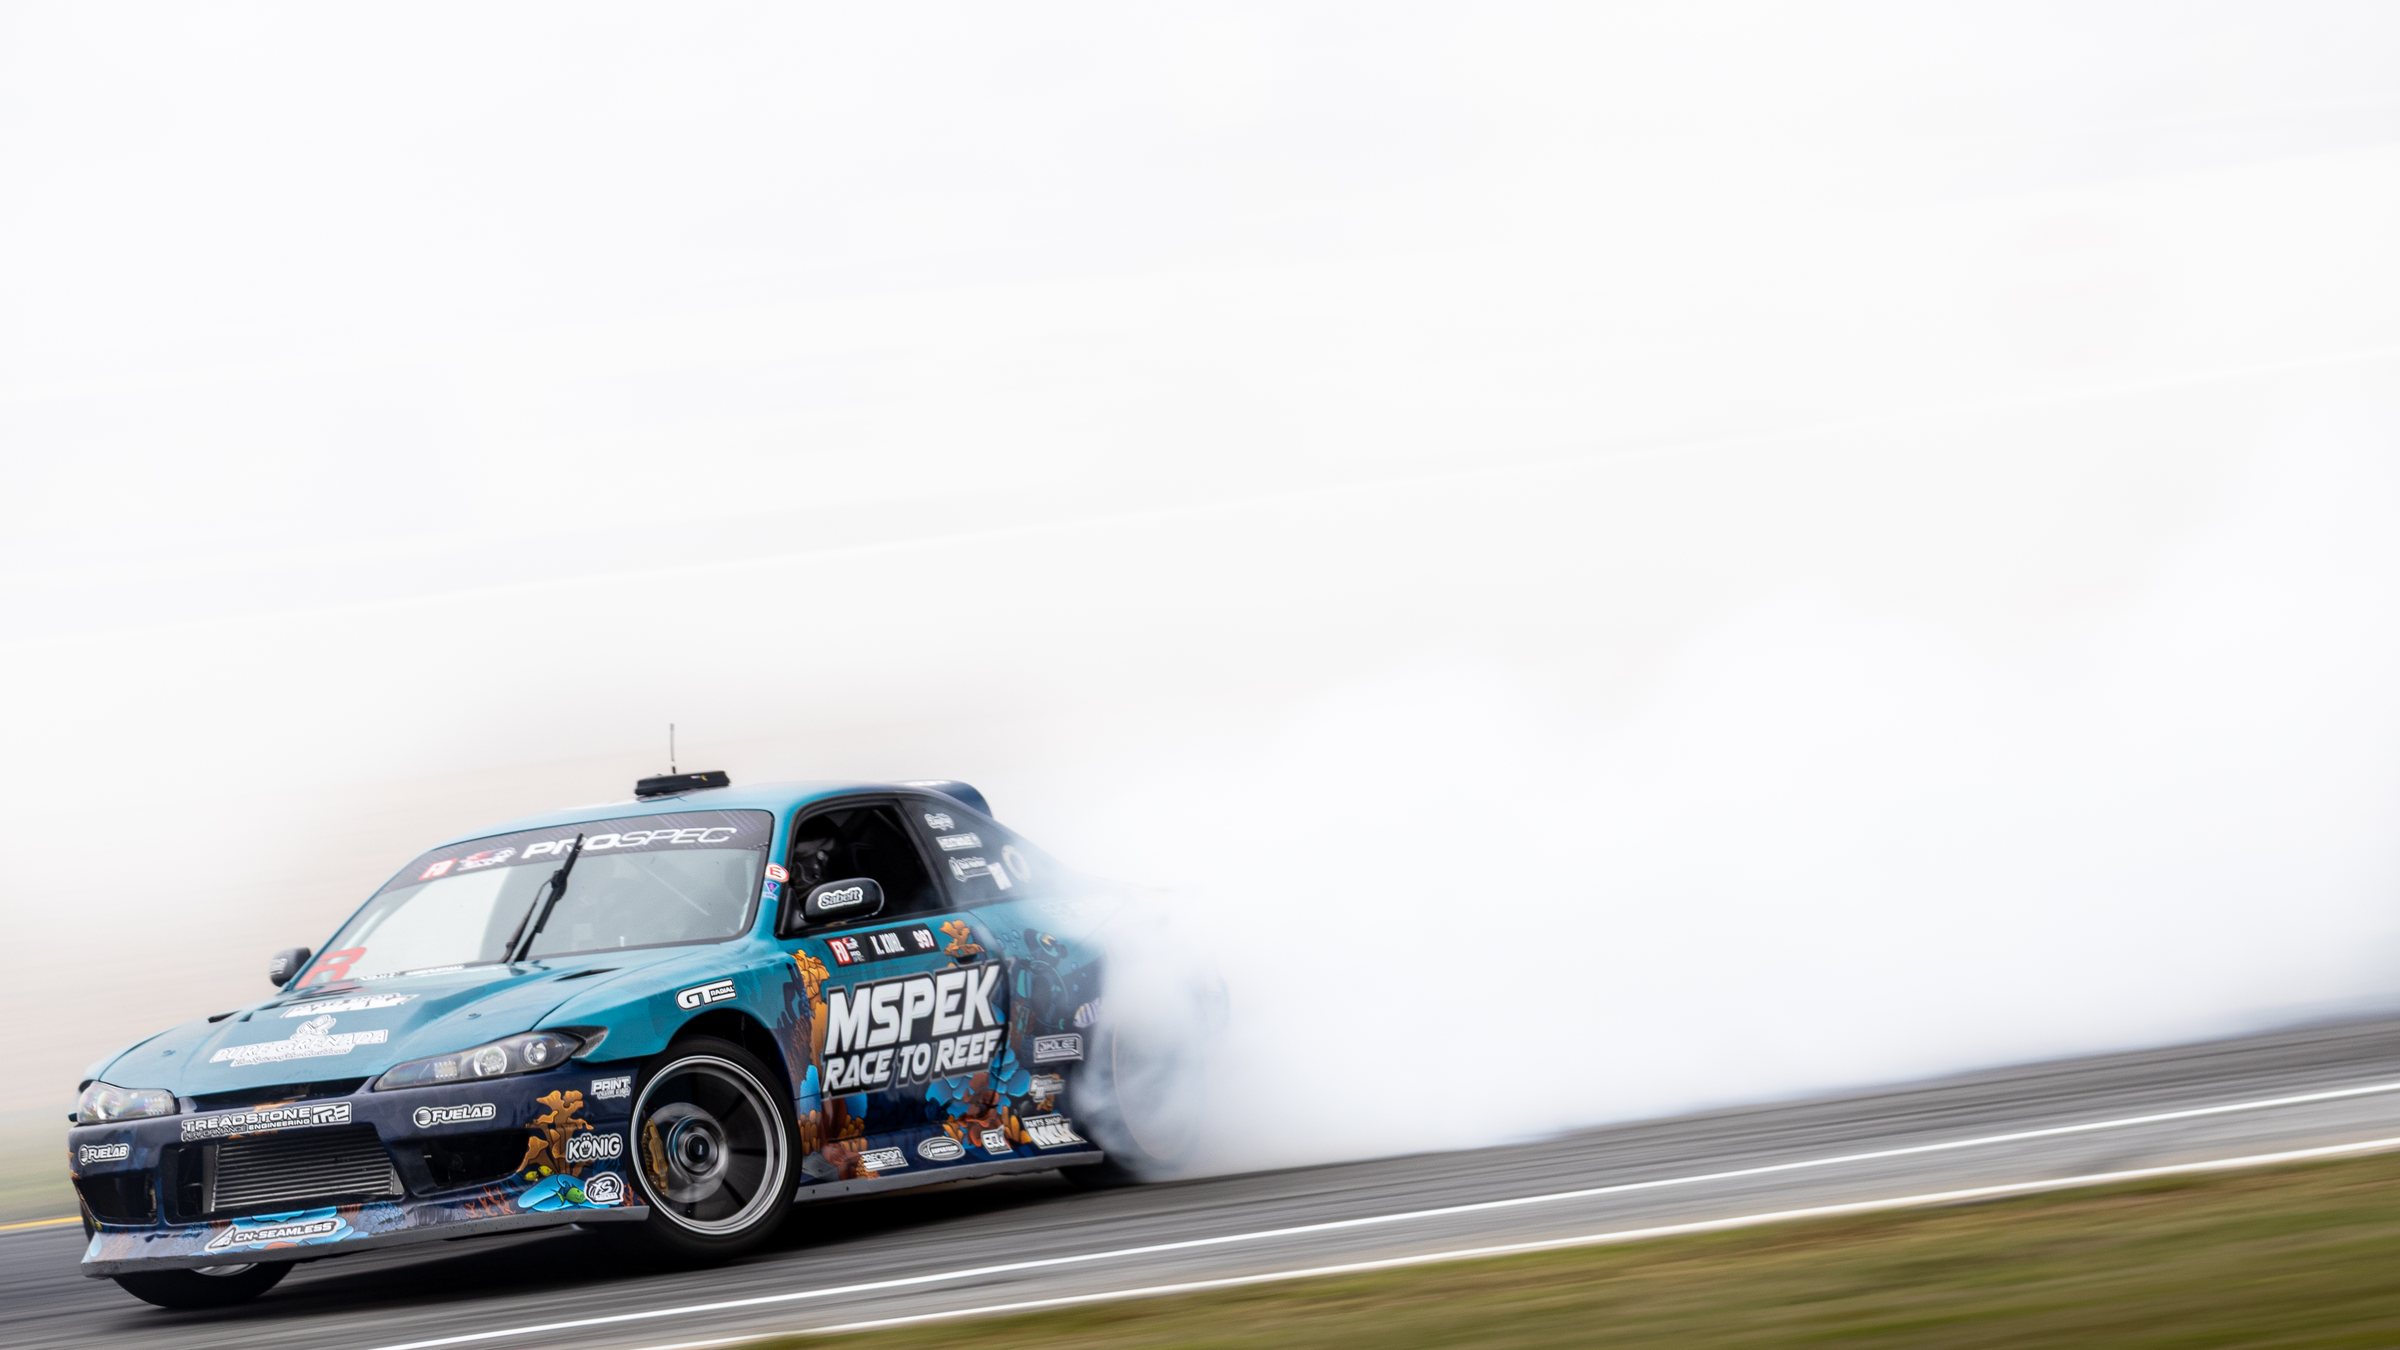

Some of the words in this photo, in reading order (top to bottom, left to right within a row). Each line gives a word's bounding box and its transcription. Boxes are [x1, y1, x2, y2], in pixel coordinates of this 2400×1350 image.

[824, 964, 1000, 1056] MSPEK
[823, 1049, 895, 1093] RACE
[900, 1043, 931, 1078] TO
[934, 1029, 1002, 1073] REEF
[183, 1107, 311, 1133] TREADSTONE
[248, 1118, 310, 1131] ENGINEERING
[432, 1106, 494, 1122] FUELAB
[88, 1146, 128, 1160] FUELAB
[569, 1134, 621, 1160] KÖNIG
[235, 1222, 333, 1242] CN-SEAMLESS
